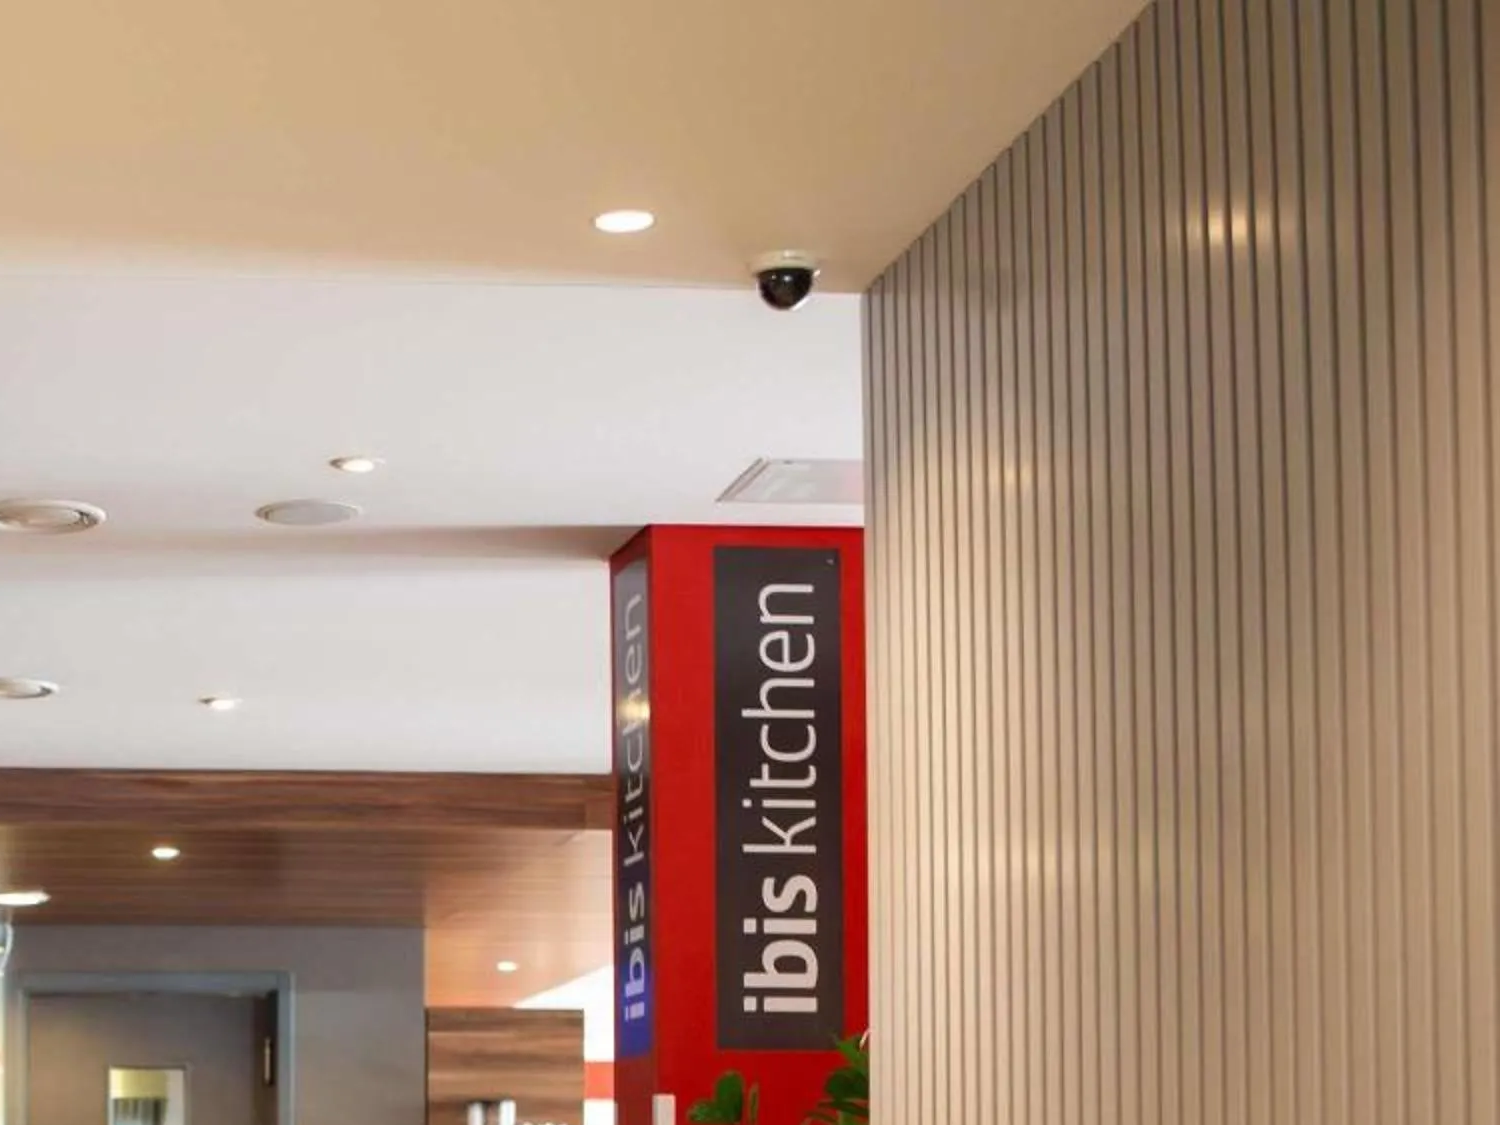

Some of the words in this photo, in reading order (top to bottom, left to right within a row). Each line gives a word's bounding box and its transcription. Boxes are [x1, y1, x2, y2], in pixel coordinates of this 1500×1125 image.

[741, 582, 818, 854] kitchen
[623, 880, 646, 1023] ibis
[742, 873, 819, 1014] ibis
